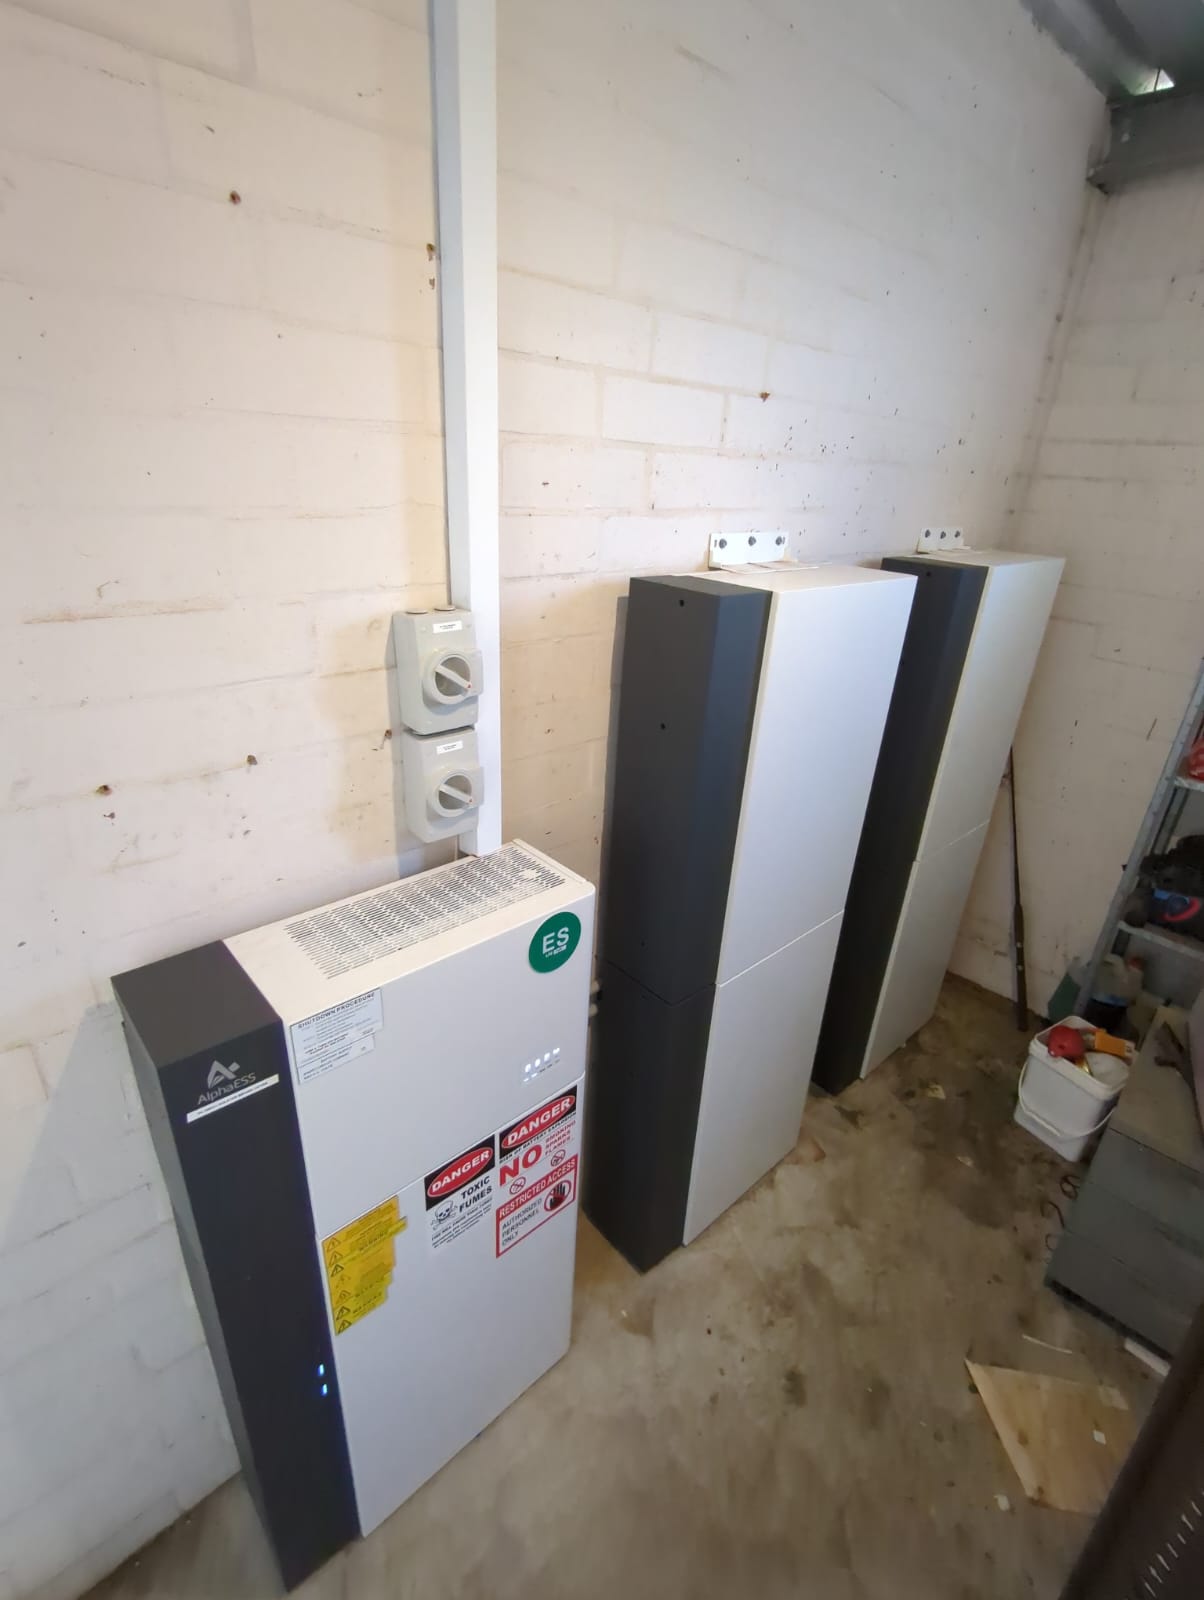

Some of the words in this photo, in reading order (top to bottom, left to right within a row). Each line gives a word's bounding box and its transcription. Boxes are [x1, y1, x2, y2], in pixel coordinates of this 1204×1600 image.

[542, 926, 569, 955] ES
[198, 1073, 257, 1105] AlphaESS
[506, 1097, 572, 1146] DANGER
[431, 1150, 490, 1193] DANGER
[499, 1144, 543, 1186] NO
[459, 1186, 493, 1213] FUMES
[460, 1176, 491, 1200] TOXIC
[499, 1180, 546, 1218] RESTRICTED
[547, 1158, 576, 1187] ACCESS
[502, 1210, 540, 1238] PERSONNEL
[502, 1231, 519, 1247] ONLY
